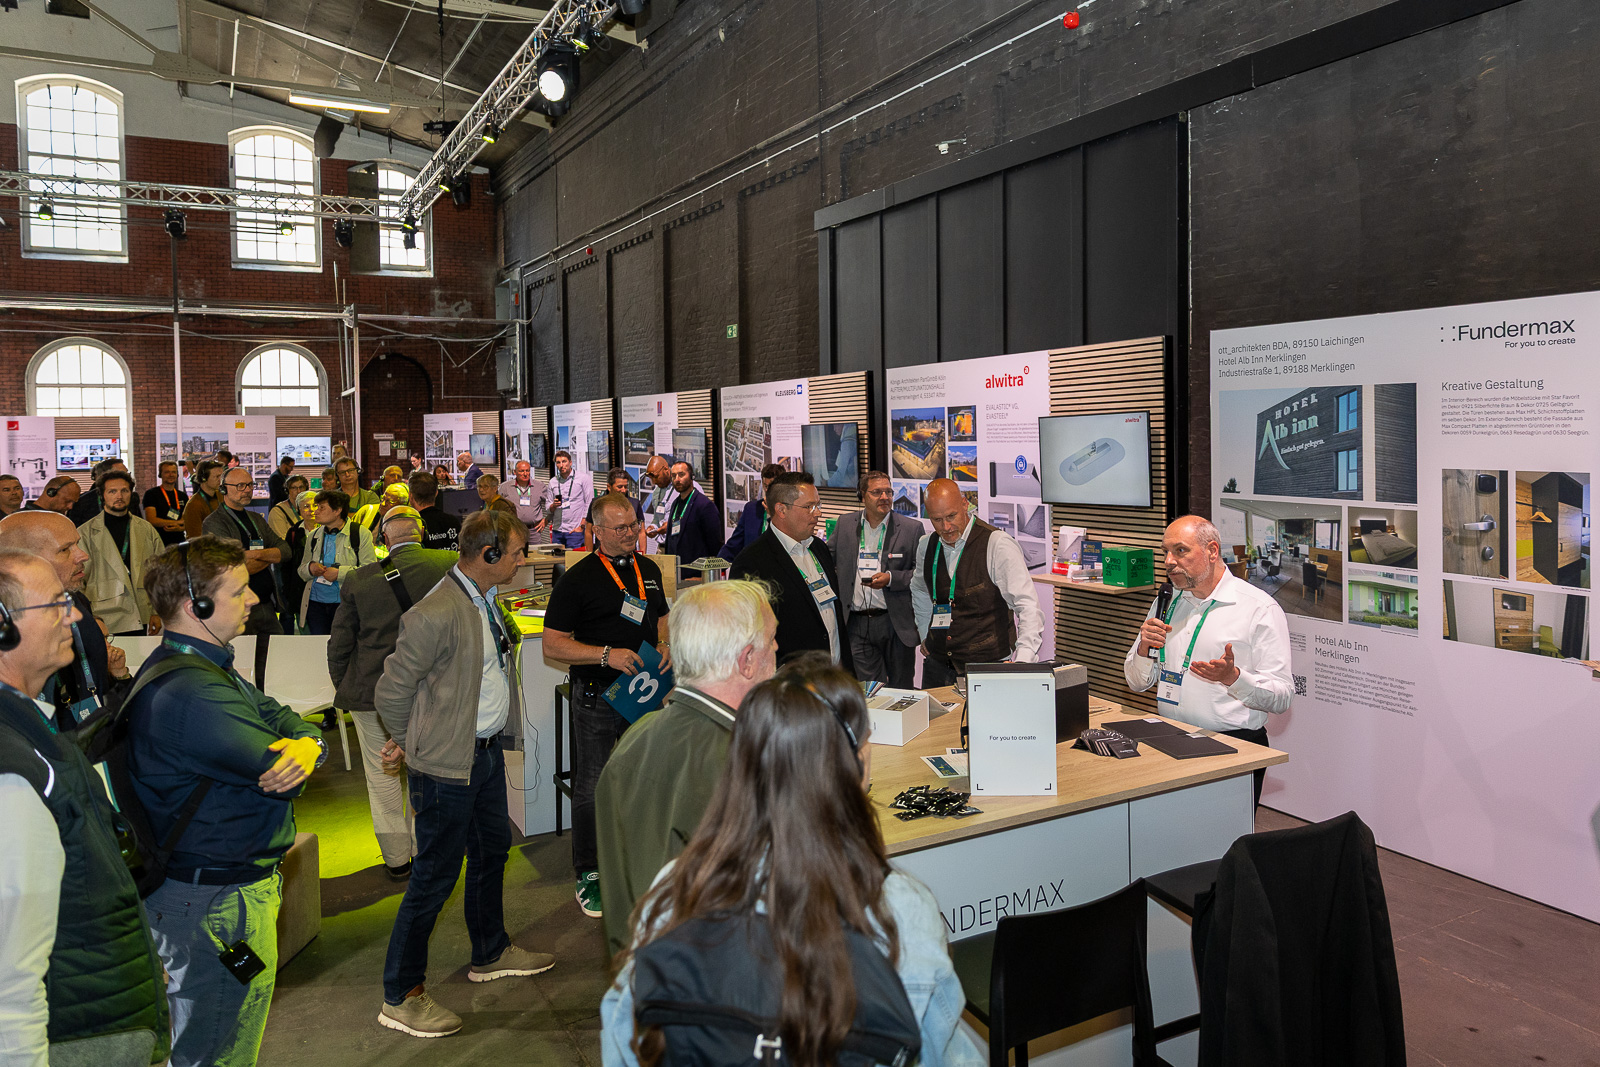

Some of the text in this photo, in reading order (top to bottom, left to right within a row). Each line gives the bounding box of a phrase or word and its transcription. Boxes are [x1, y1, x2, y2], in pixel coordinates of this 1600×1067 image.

[1458, 319, 1575, 341] Fundermax
[1218, 336, 1364, 356] ott_architekten BDA, 89150 Laichingen
[1520, 340, 1535, 349] you
[1548, 337, 1576, 346] create
[1218, 353, 1306, 366] Hotel Alb Inn Merklingen
[1218, 362, 1355, 378] Industriestraße 1, 89188 Merklingen
[985, 373, 1024, 389] alwitra
[1441, 379, 1544, 391] Kreative Gestaltung
[775, 389, 796, 397] KLEUSBERG
[1275, 393, 1318, 420] HOTEL
[1258, 415, 1319, 469] Alb inn
[1315, 634, 1337, 647] Hotel
[1338, 639, 1352, 649] Alb
[1354, 642, 1369, 652] Inn
[1315, 647, 1360, 664] Merklingen
[628, 671, 659, 704] 3
